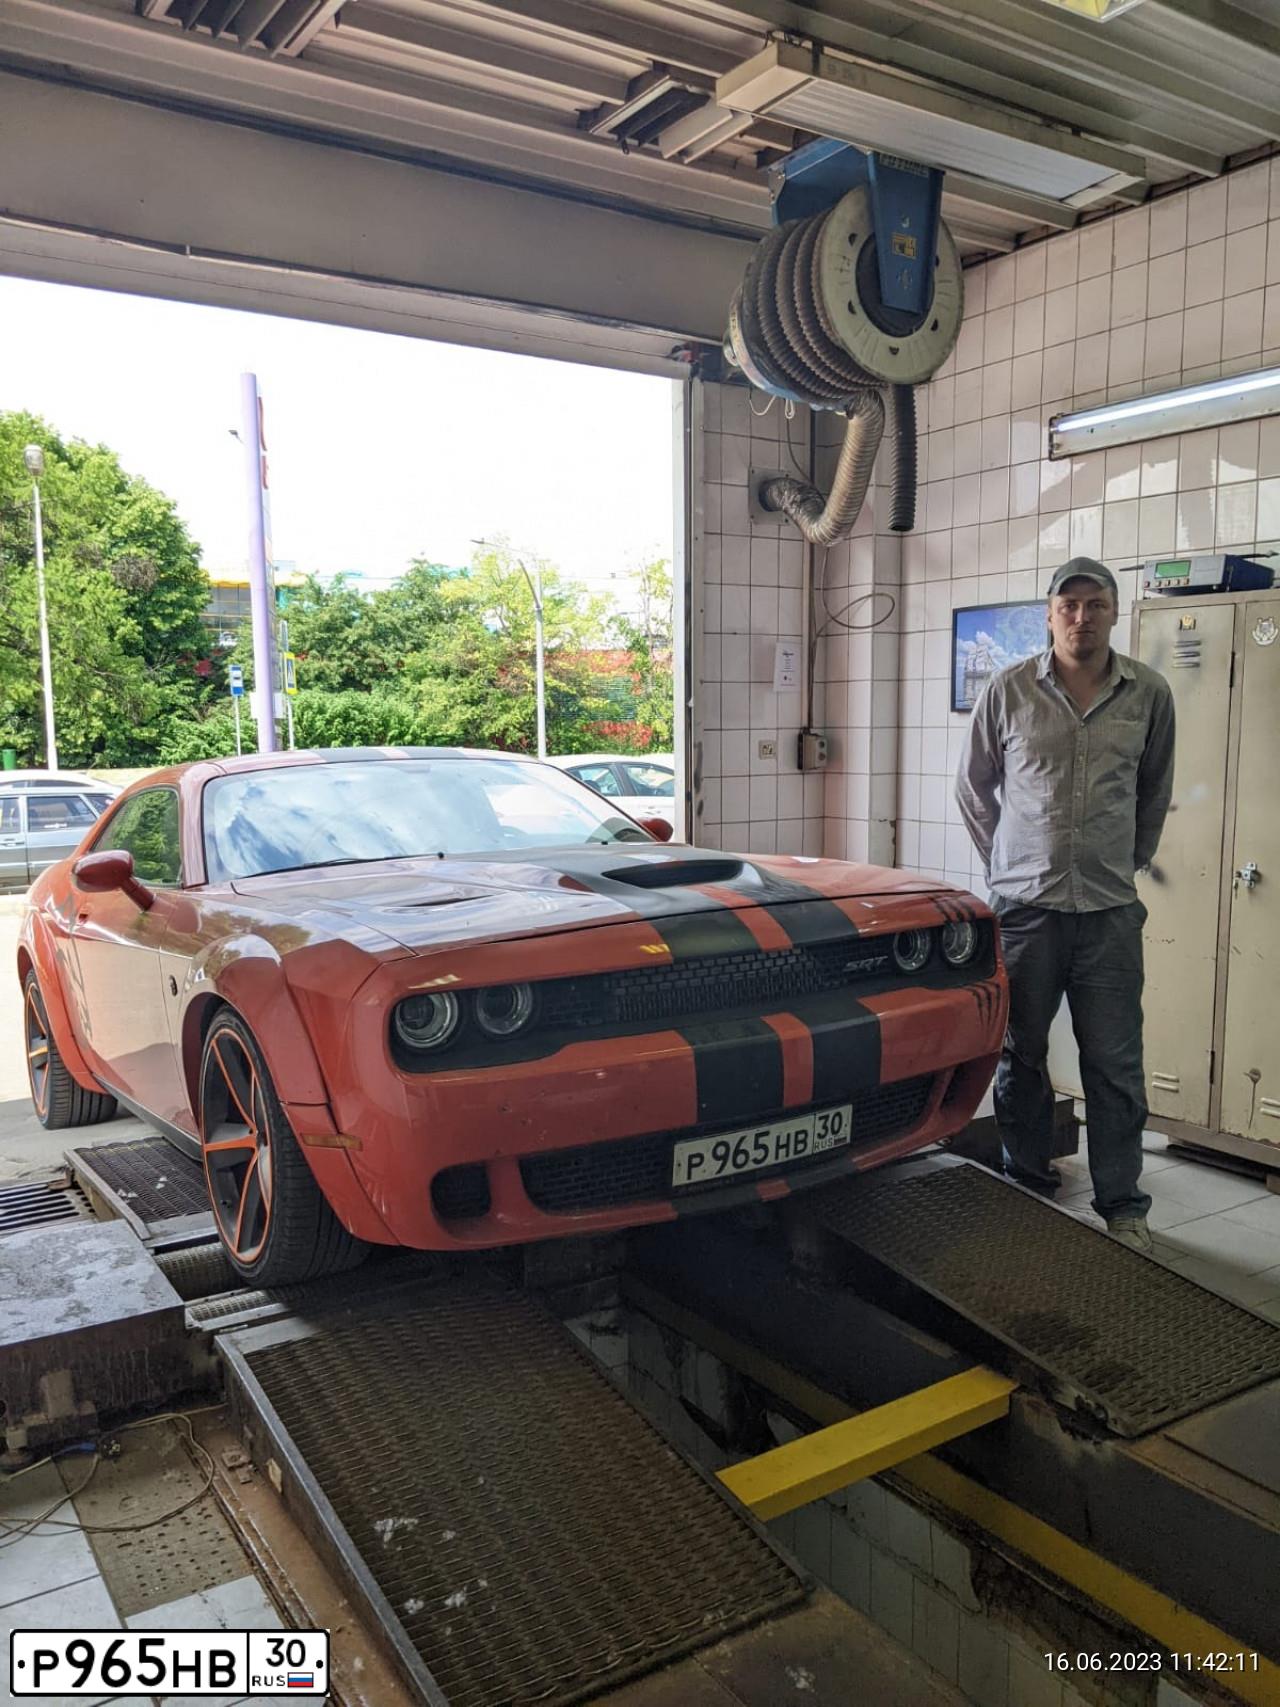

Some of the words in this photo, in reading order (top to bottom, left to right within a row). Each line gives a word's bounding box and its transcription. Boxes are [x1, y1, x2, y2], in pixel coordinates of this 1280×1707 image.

[842, 955, 889, 973] SRT
[686, 1129, 808, 1181] Р965НВ
[816, 1111, 843, 1140] 30
[814, 1137, 834, 1151] RUS
